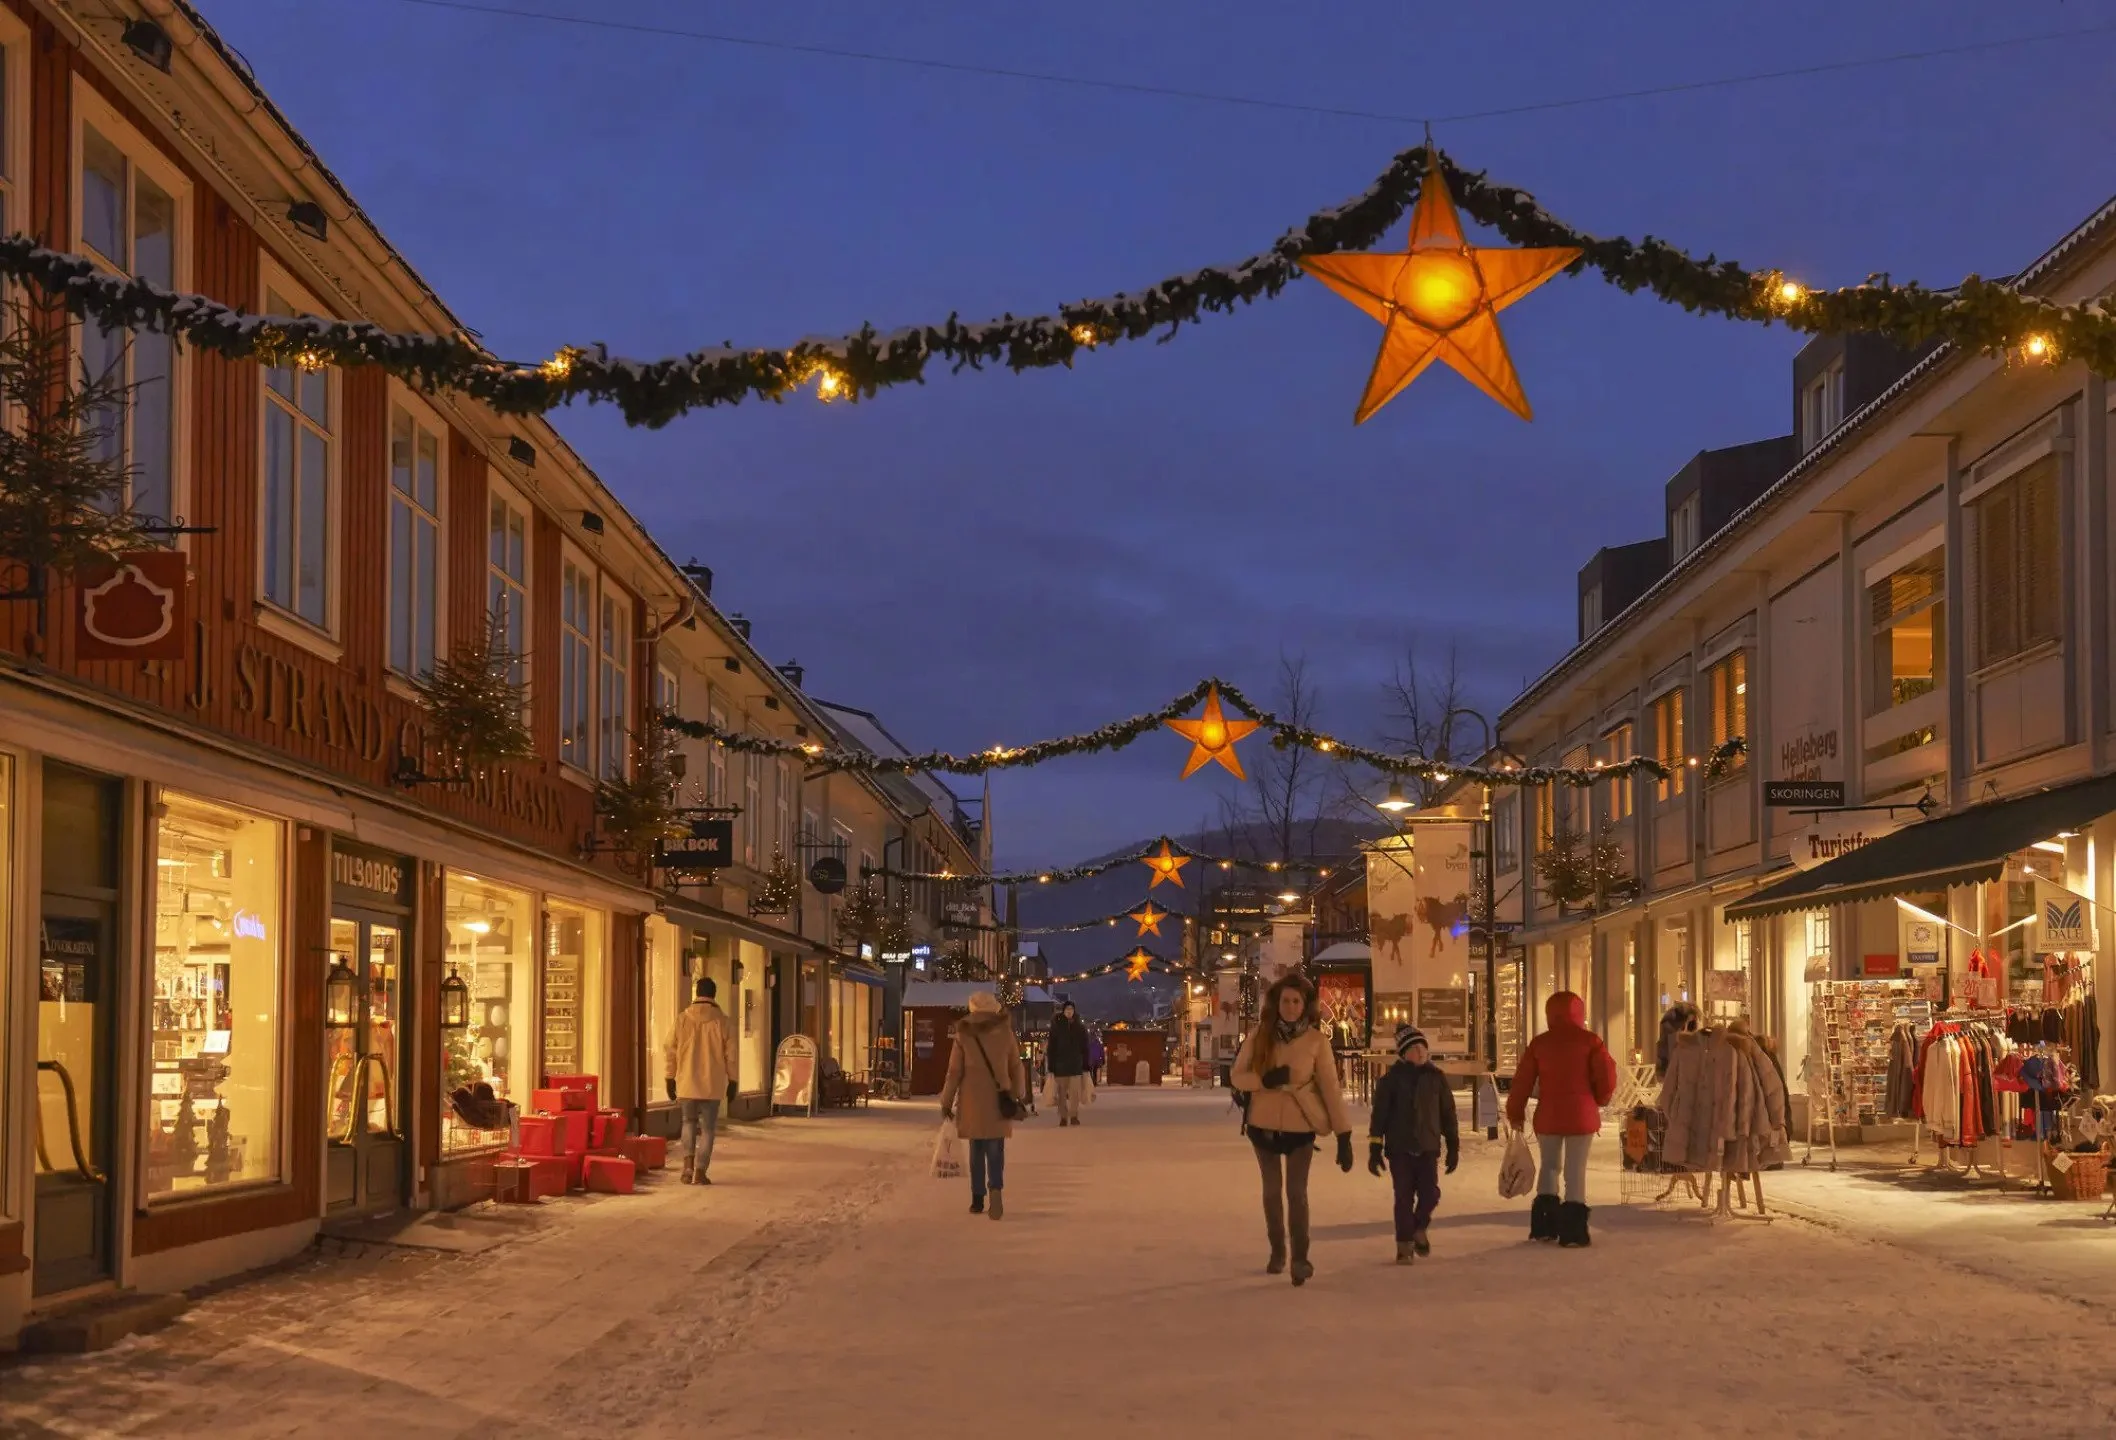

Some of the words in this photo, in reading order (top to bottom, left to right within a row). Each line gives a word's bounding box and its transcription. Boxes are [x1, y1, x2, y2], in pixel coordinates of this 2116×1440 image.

[235, 641, 387, 762] STRAND
[1780, 729, 1837, 771] Helleberg
[1770, 788, 1840, 800] SKORINGEN
[663, 838, 687, 851] BIK
[688, 838, 719, 851] BOK
[2048, 929, 2083, 940] DALE
